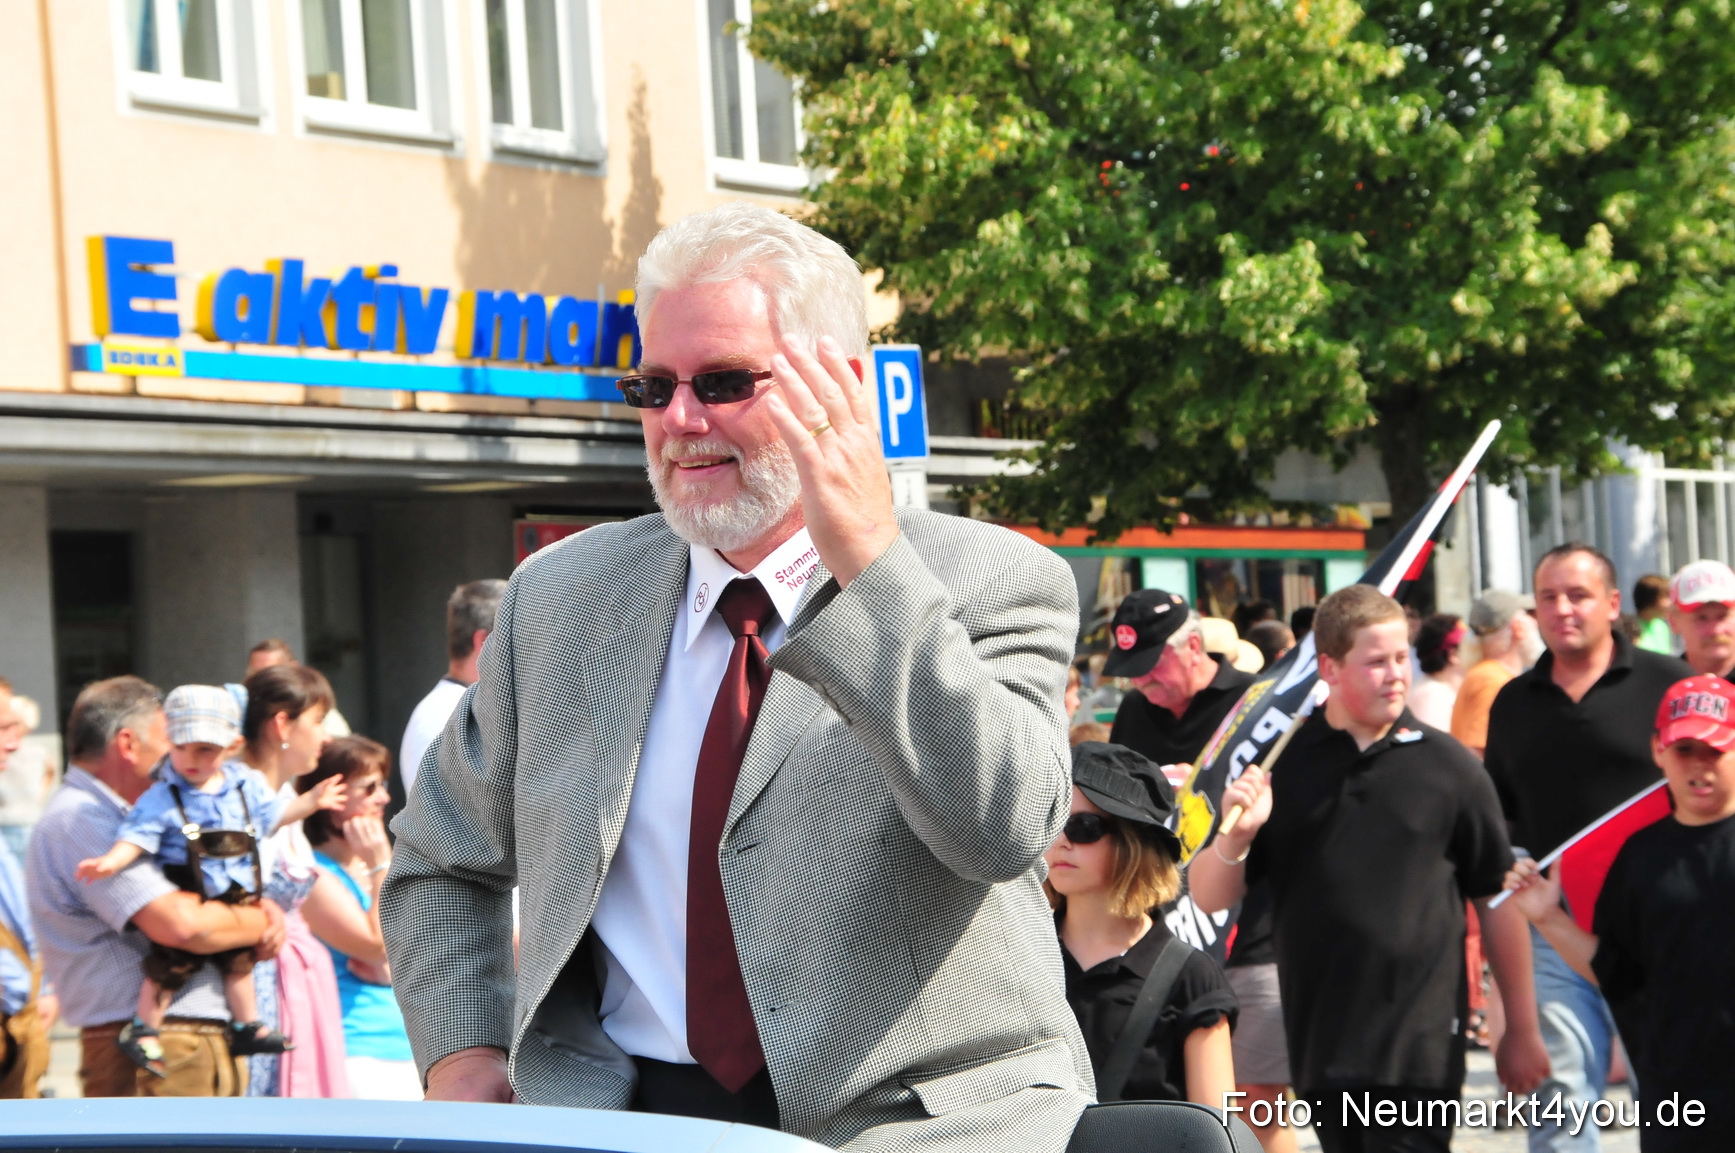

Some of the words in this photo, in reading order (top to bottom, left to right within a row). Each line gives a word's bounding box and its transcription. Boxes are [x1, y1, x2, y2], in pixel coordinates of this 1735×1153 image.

[103, 235, 179, 338] E
[213, 258, 449, 355] aktiv
[883, 361, 913, 447] P
